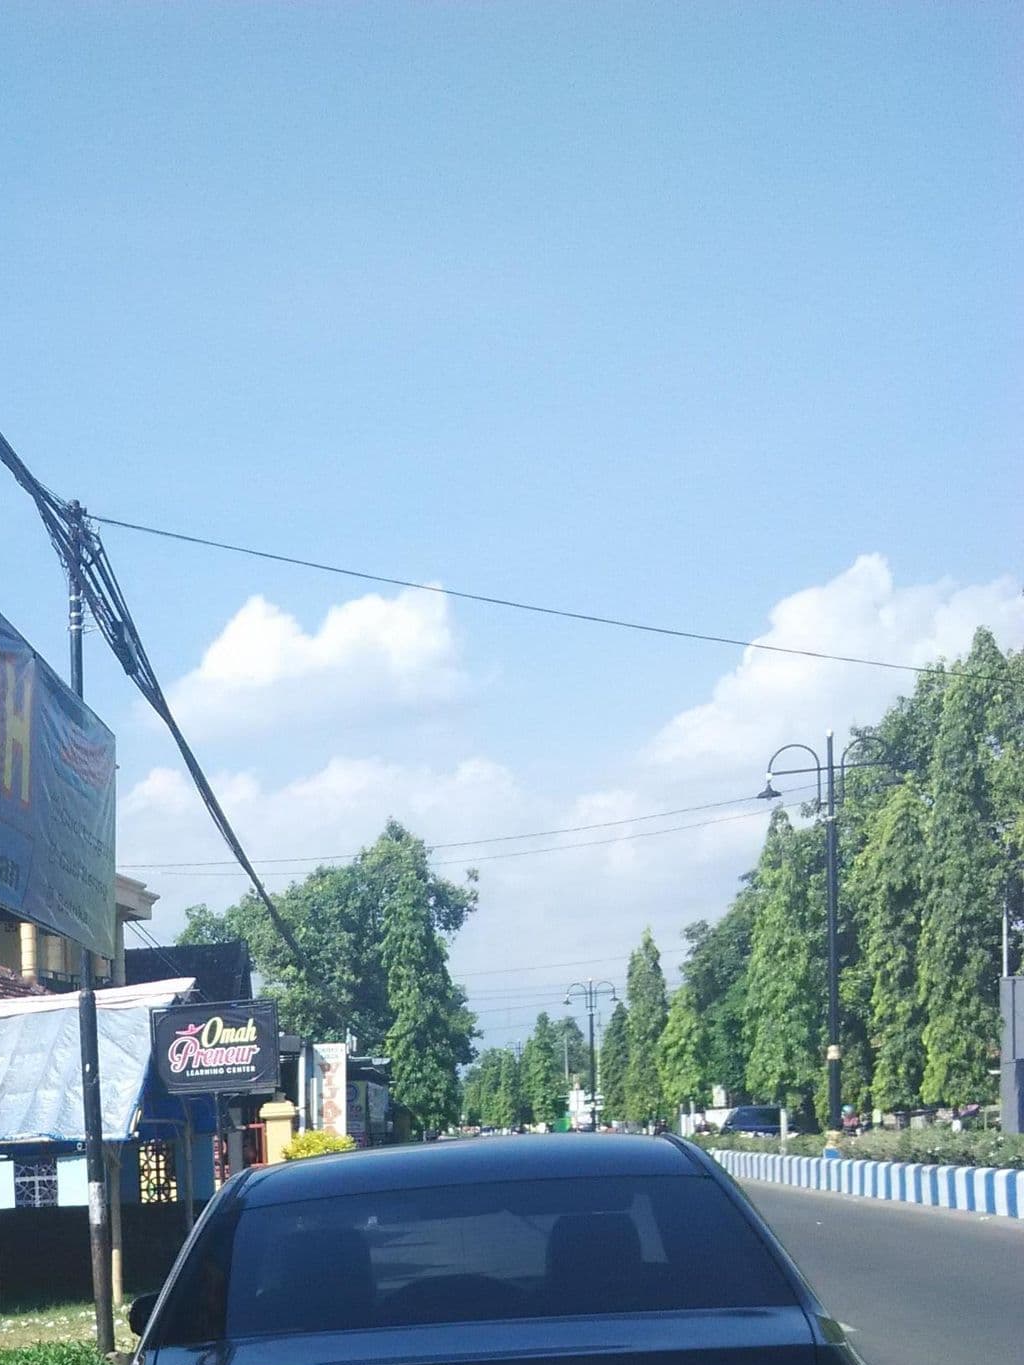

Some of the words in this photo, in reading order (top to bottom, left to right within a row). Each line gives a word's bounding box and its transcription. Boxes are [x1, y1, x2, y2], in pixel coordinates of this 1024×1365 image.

[201, 1016, 257, 1048] Omah
[168, 1036, 261, 1073] Preneur
[186, 1067, 225, 1077] LEARNING
[226, 1065, 256, 1075] CENTER
